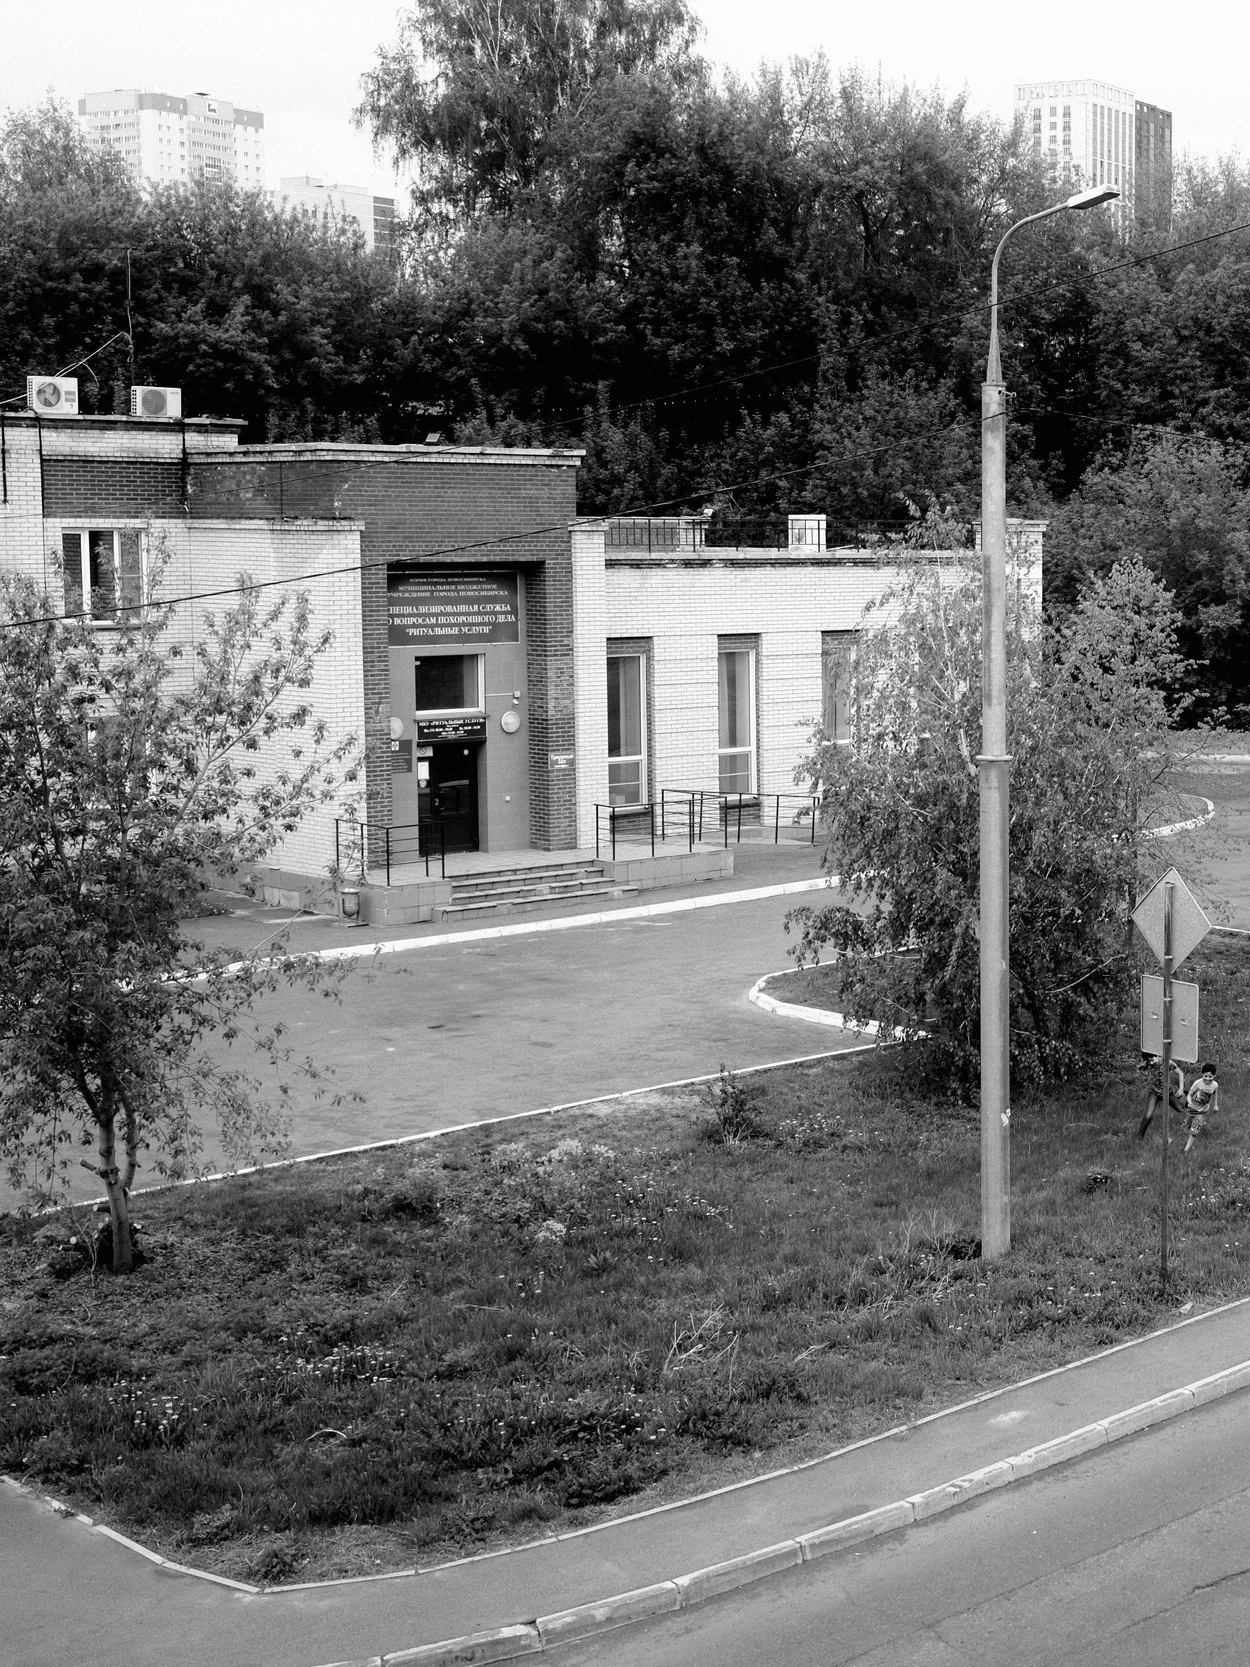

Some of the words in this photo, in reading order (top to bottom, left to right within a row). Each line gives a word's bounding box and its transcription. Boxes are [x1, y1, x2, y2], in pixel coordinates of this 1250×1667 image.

[479, 603, 511, 612] СЛУЖБА
[393, 616, 436, 625] ВОПРОСАМ
[437, 615, 496, 624] ПОХОРОННОГО
[496, 614, 516, 623] ДЕЛА
